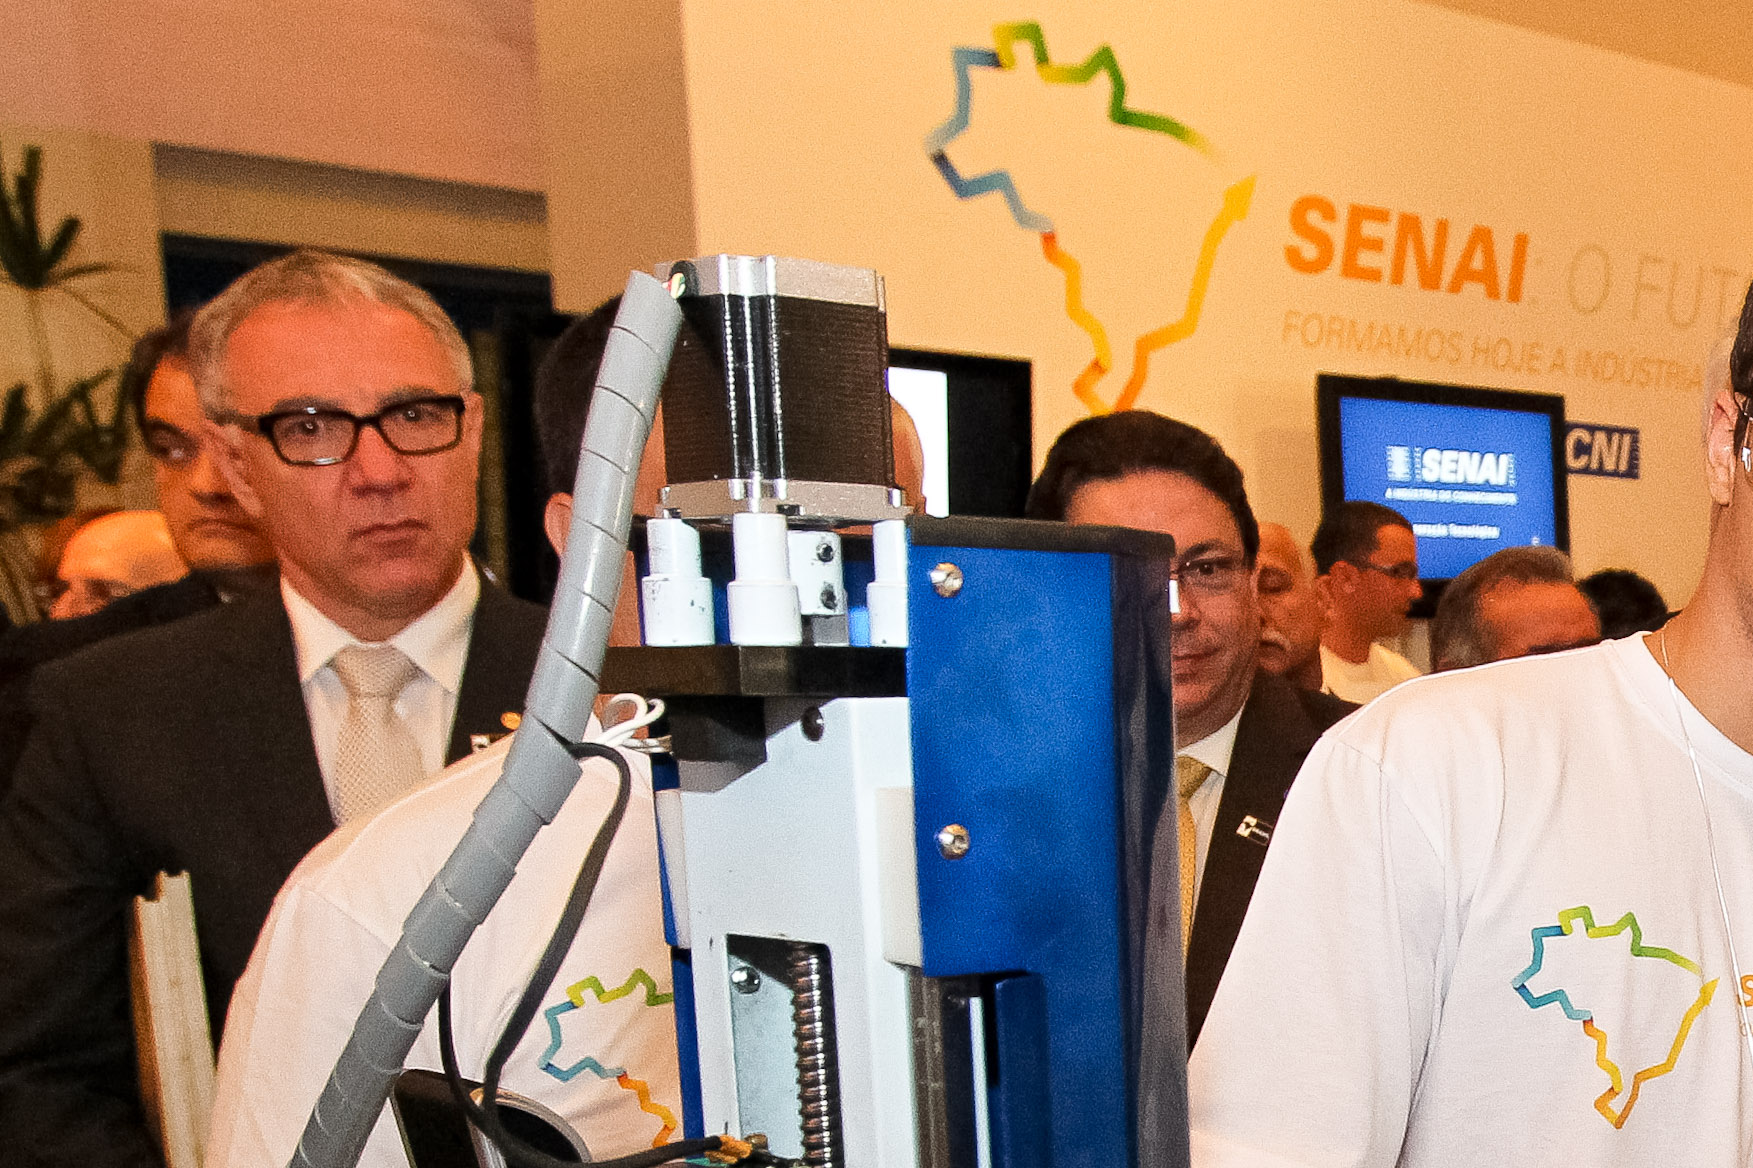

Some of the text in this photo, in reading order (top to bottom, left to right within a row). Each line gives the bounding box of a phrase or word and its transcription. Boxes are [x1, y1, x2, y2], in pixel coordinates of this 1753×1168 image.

[1568, 243, 1611, 315] O
[1630, 254, 1739, 330] FUT
[1282, 309, 1464, 366] FORMAMOS
[1470, 333, 1543, 375] HOJE
[1549, 346, 1567, 374] A
[1421, 448, 1510, 486] SENAI
[1564, 427, 1632, 474] CNI
